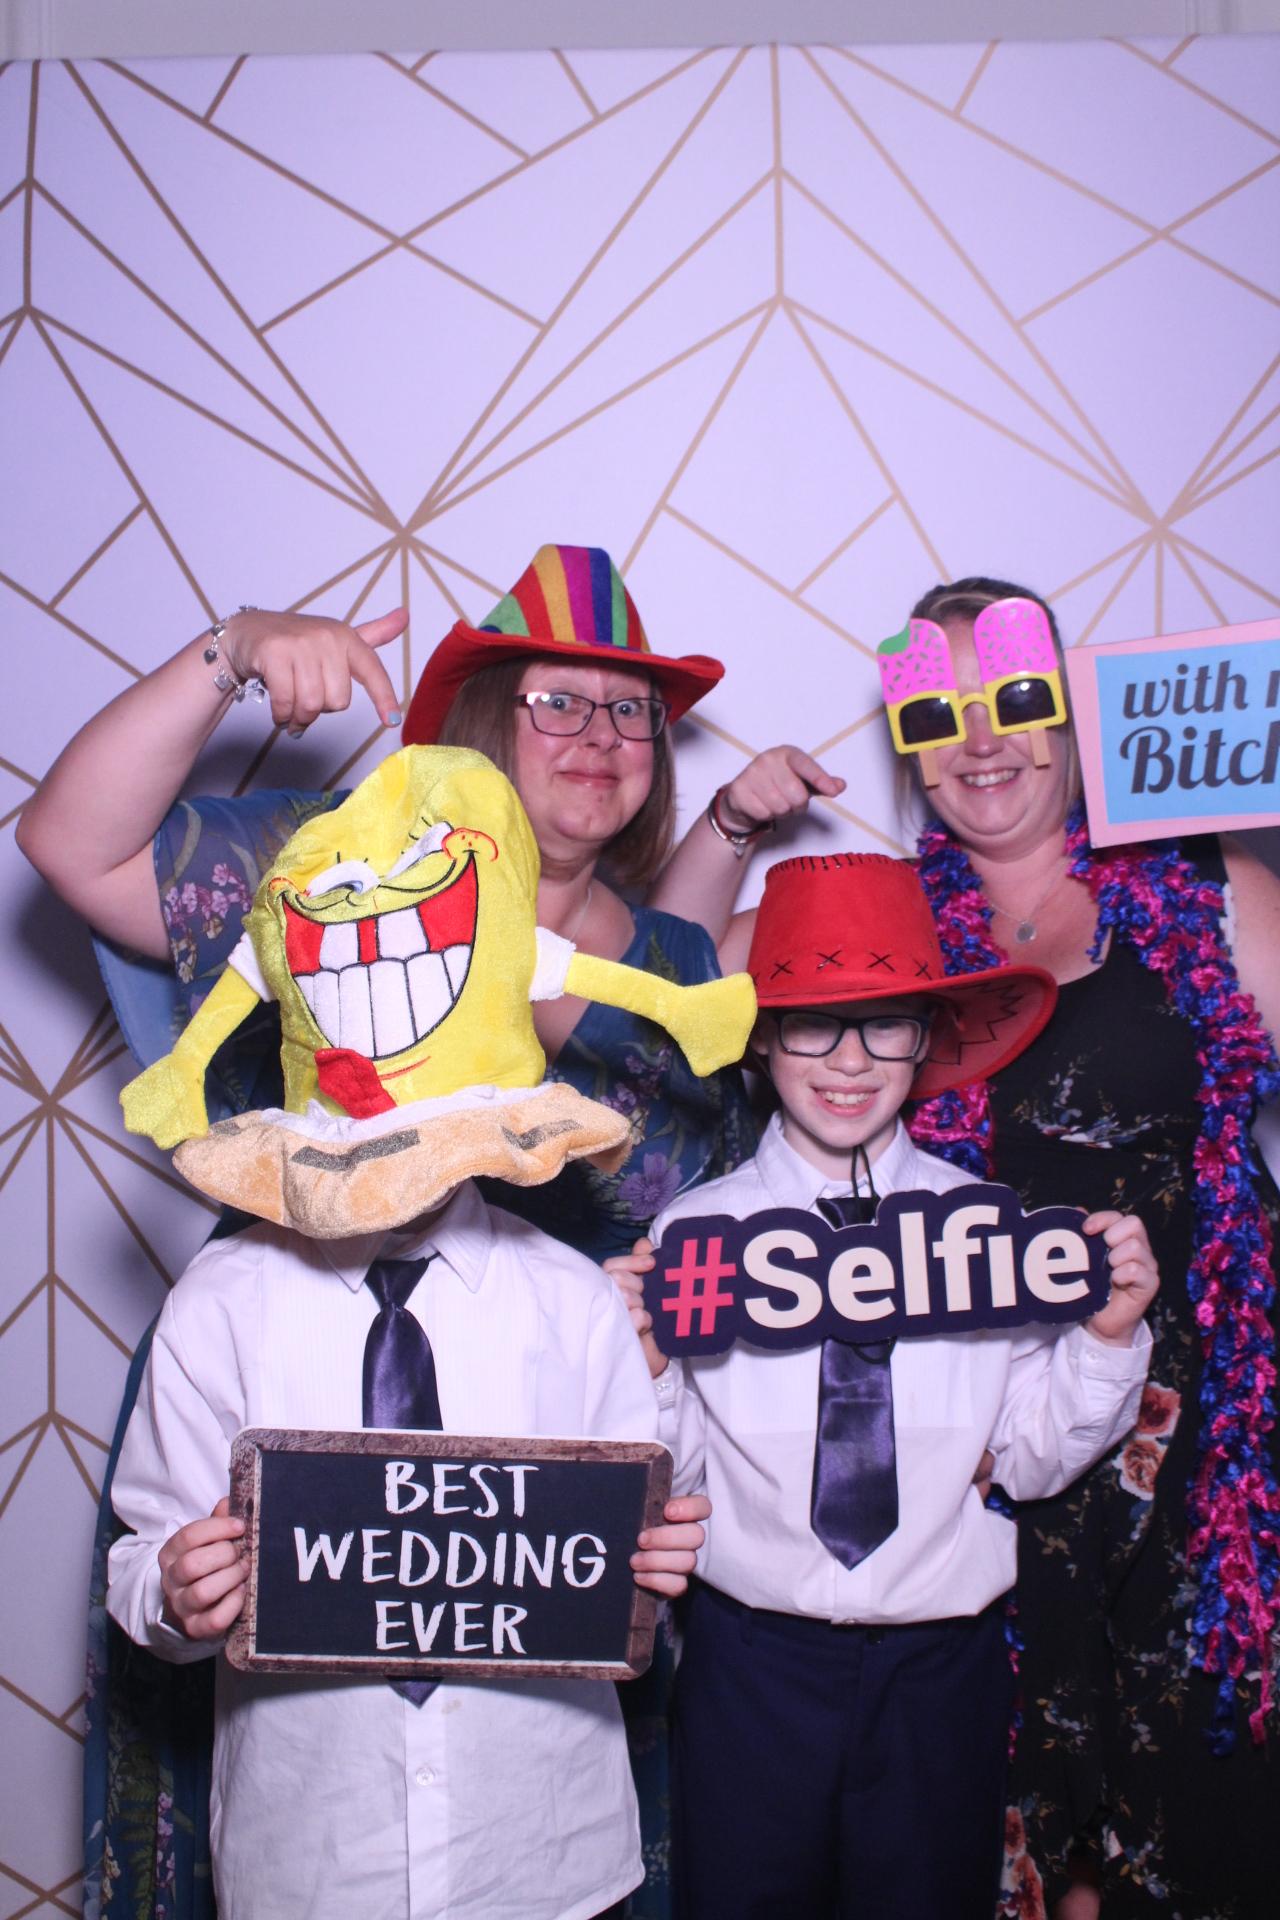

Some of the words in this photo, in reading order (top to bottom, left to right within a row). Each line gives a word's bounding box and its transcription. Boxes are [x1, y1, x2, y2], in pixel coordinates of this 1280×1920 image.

[1123, 660, 1248, 719] with
[662, 1205, 1090, 1337] #Selfie
[385, 1461, 539, 1518] BEST
[294, 1527, 606, 1588] WEDDING
[375, 1600, 528, 1654] EVER
